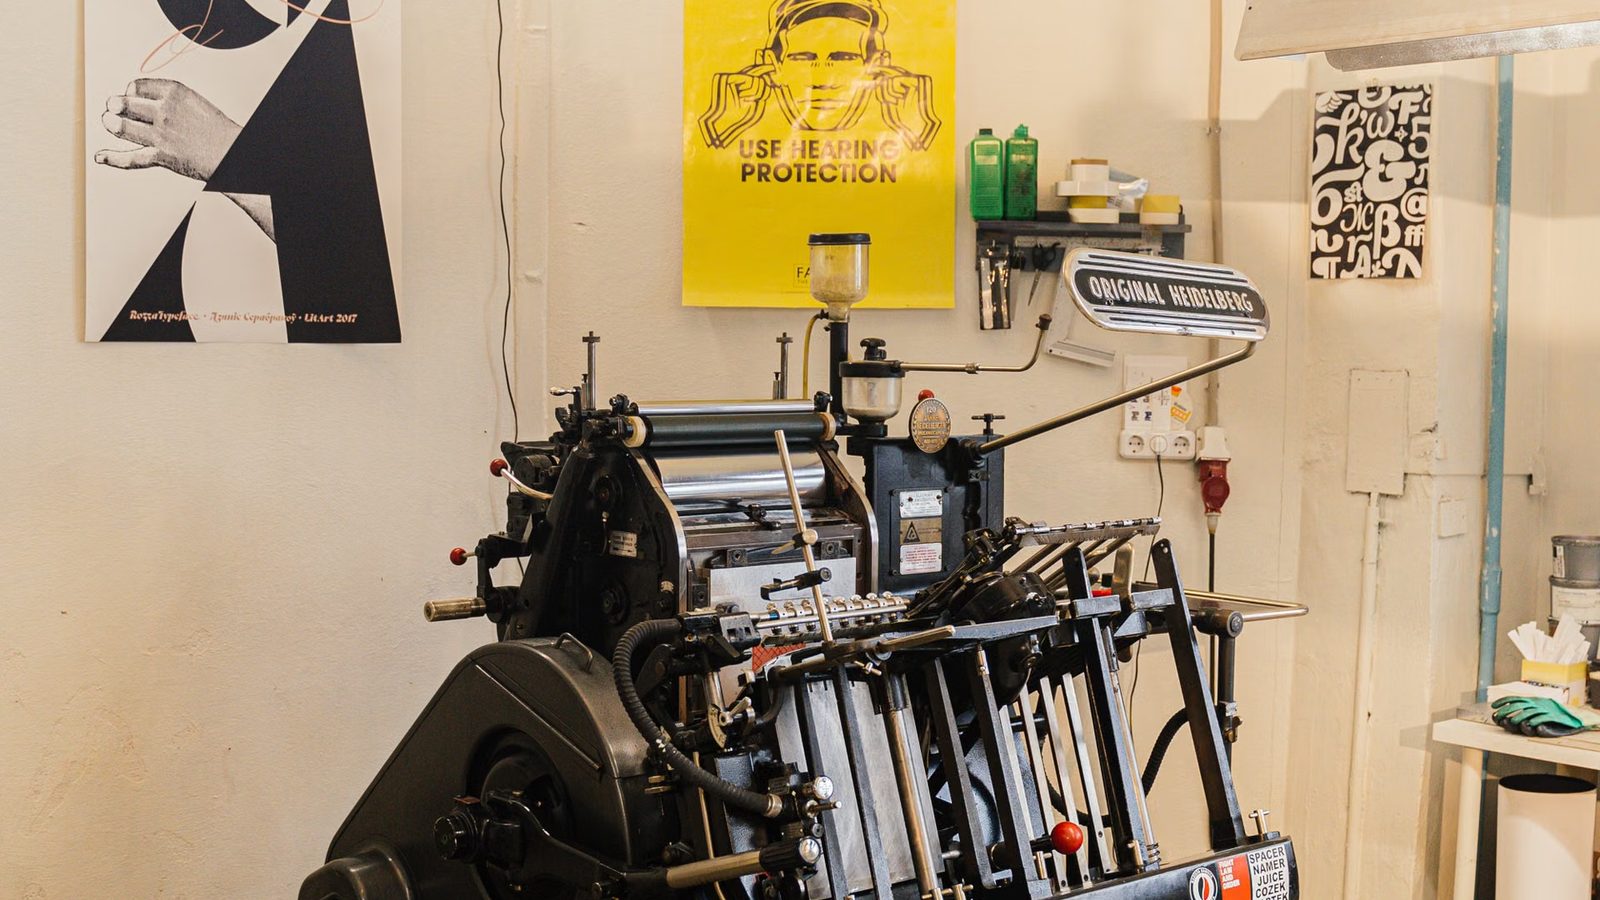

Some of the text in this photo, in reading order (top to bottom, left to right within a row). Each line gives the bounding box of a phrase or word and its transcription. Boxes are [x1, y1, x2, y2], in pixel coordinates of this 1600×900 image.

[739, 139, 899, 160] USE HEARING
[741, 163, 897, 183] PROTECTION
[1089, 276, 1254, 313] ORIGINAL HEIDELBERG
[335, 313, 358, 324] 2017
[1249, 846, 1285, 864] SPACER
[1253, 858, 1286, 875] NAMER
[1257, 870, 1284, 887] JUICE
[1255, 881, 1286, 899] COZEK
